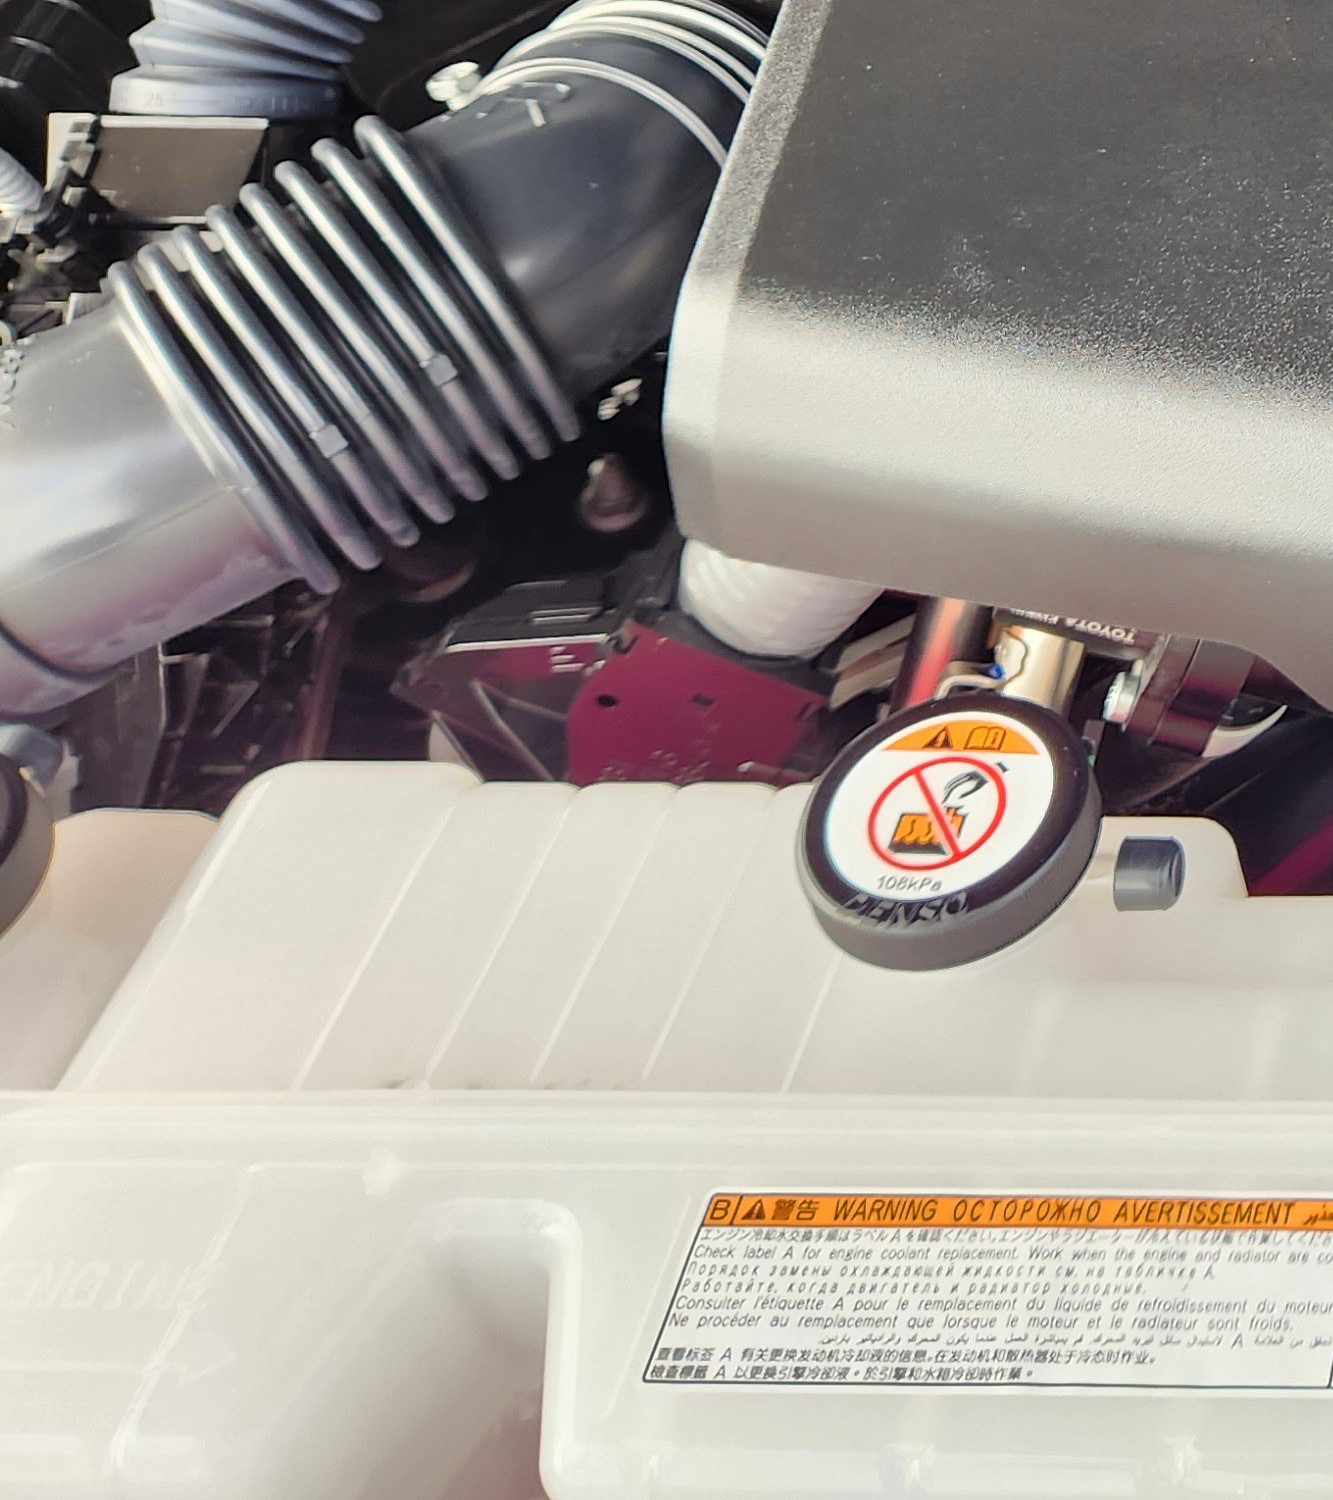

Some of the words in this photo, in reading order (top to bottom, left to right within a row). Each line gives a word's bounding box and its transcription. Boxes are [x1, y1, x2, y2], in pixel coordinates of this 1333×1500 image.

[1064, 617, 1138, 645] TOYOTA
[843, 891, 970, 928] DENSO
[709, 1199, 731, 1221] B
[771, 1198, 820, 1221] 警告
[833, 1198, 938, 1222] WARNING
[953, 1198, 1101, 1223] ОСТОРОЖНО
[1113, 1200, 1296, 1225] AVERTISSEMENT
[693, 1245, 736, 1259] Check
[743, 1245, 775, 1259] label
[782, 1246, 794, 1259] A
[803, 1245, 821, 1259] for
[829, 1247, 873, 1262] engine
[880, 1246, 931, 1260] coolant
[1028, 1246, 1064, 1259] Work
[1072, 1246, 1106, 1260] when
[1114, 1248, 1135, 1261] the
[1143, 1249, 1188, 1264] engine
[1195, 1249, 1221, 1263] and
[1228, 1250, 1280, 1263] radiator
[1288, 1253, 1309, 1264] are
[687, 1261, 760, 1277] Порядок
[769, 1264, 832, 1277] замены
[787, 1281, 838, 1295] когда
[846, 1282, 940, 1295] двигатель
[950, 1282, 960, 1294] и
[968, 1282, 1051, 1296] радиатор
[675, 1296, 746, 1311] Consulter
[832, 1297, 844, 1311] A
[853, 1299, 887, 1312] pour
[896, 1298, 910, 1311] le
[917, 1298, 1017, 1312] remplacement
[1026, 1299, 1045, 1311] du
[1054, 1299, 1101, 1312] liquide
[1111, 1299, 1129, 1312] de
[1137, 1299, 1247, 1313] refroidissement
[1256, 1300, 1275, 1313] du
[668, 1313, 689, 1327] Ne
[696, 1312, 762, 1329] procéder
[770, 1316, 790, 1328] au
[797, 1314, 898, 1329] remplacement
[907, 1316, 934, 1329] que
[943, 1315, 997, 1329] lorsque
[1006, 1315, 1019, 1328] le
[1027, 1316, 1079, 1329] moteur
[1087, 1316, 1101, 1329] et
[1110, 1316, 1123, 1329] le
[1131, 1316, 1198, 1330] radiateur
[1207, 1317, 1239, 1330] sont
[719, 1347, 733, 1361] A
[713, 1365, 727, 1380] A
